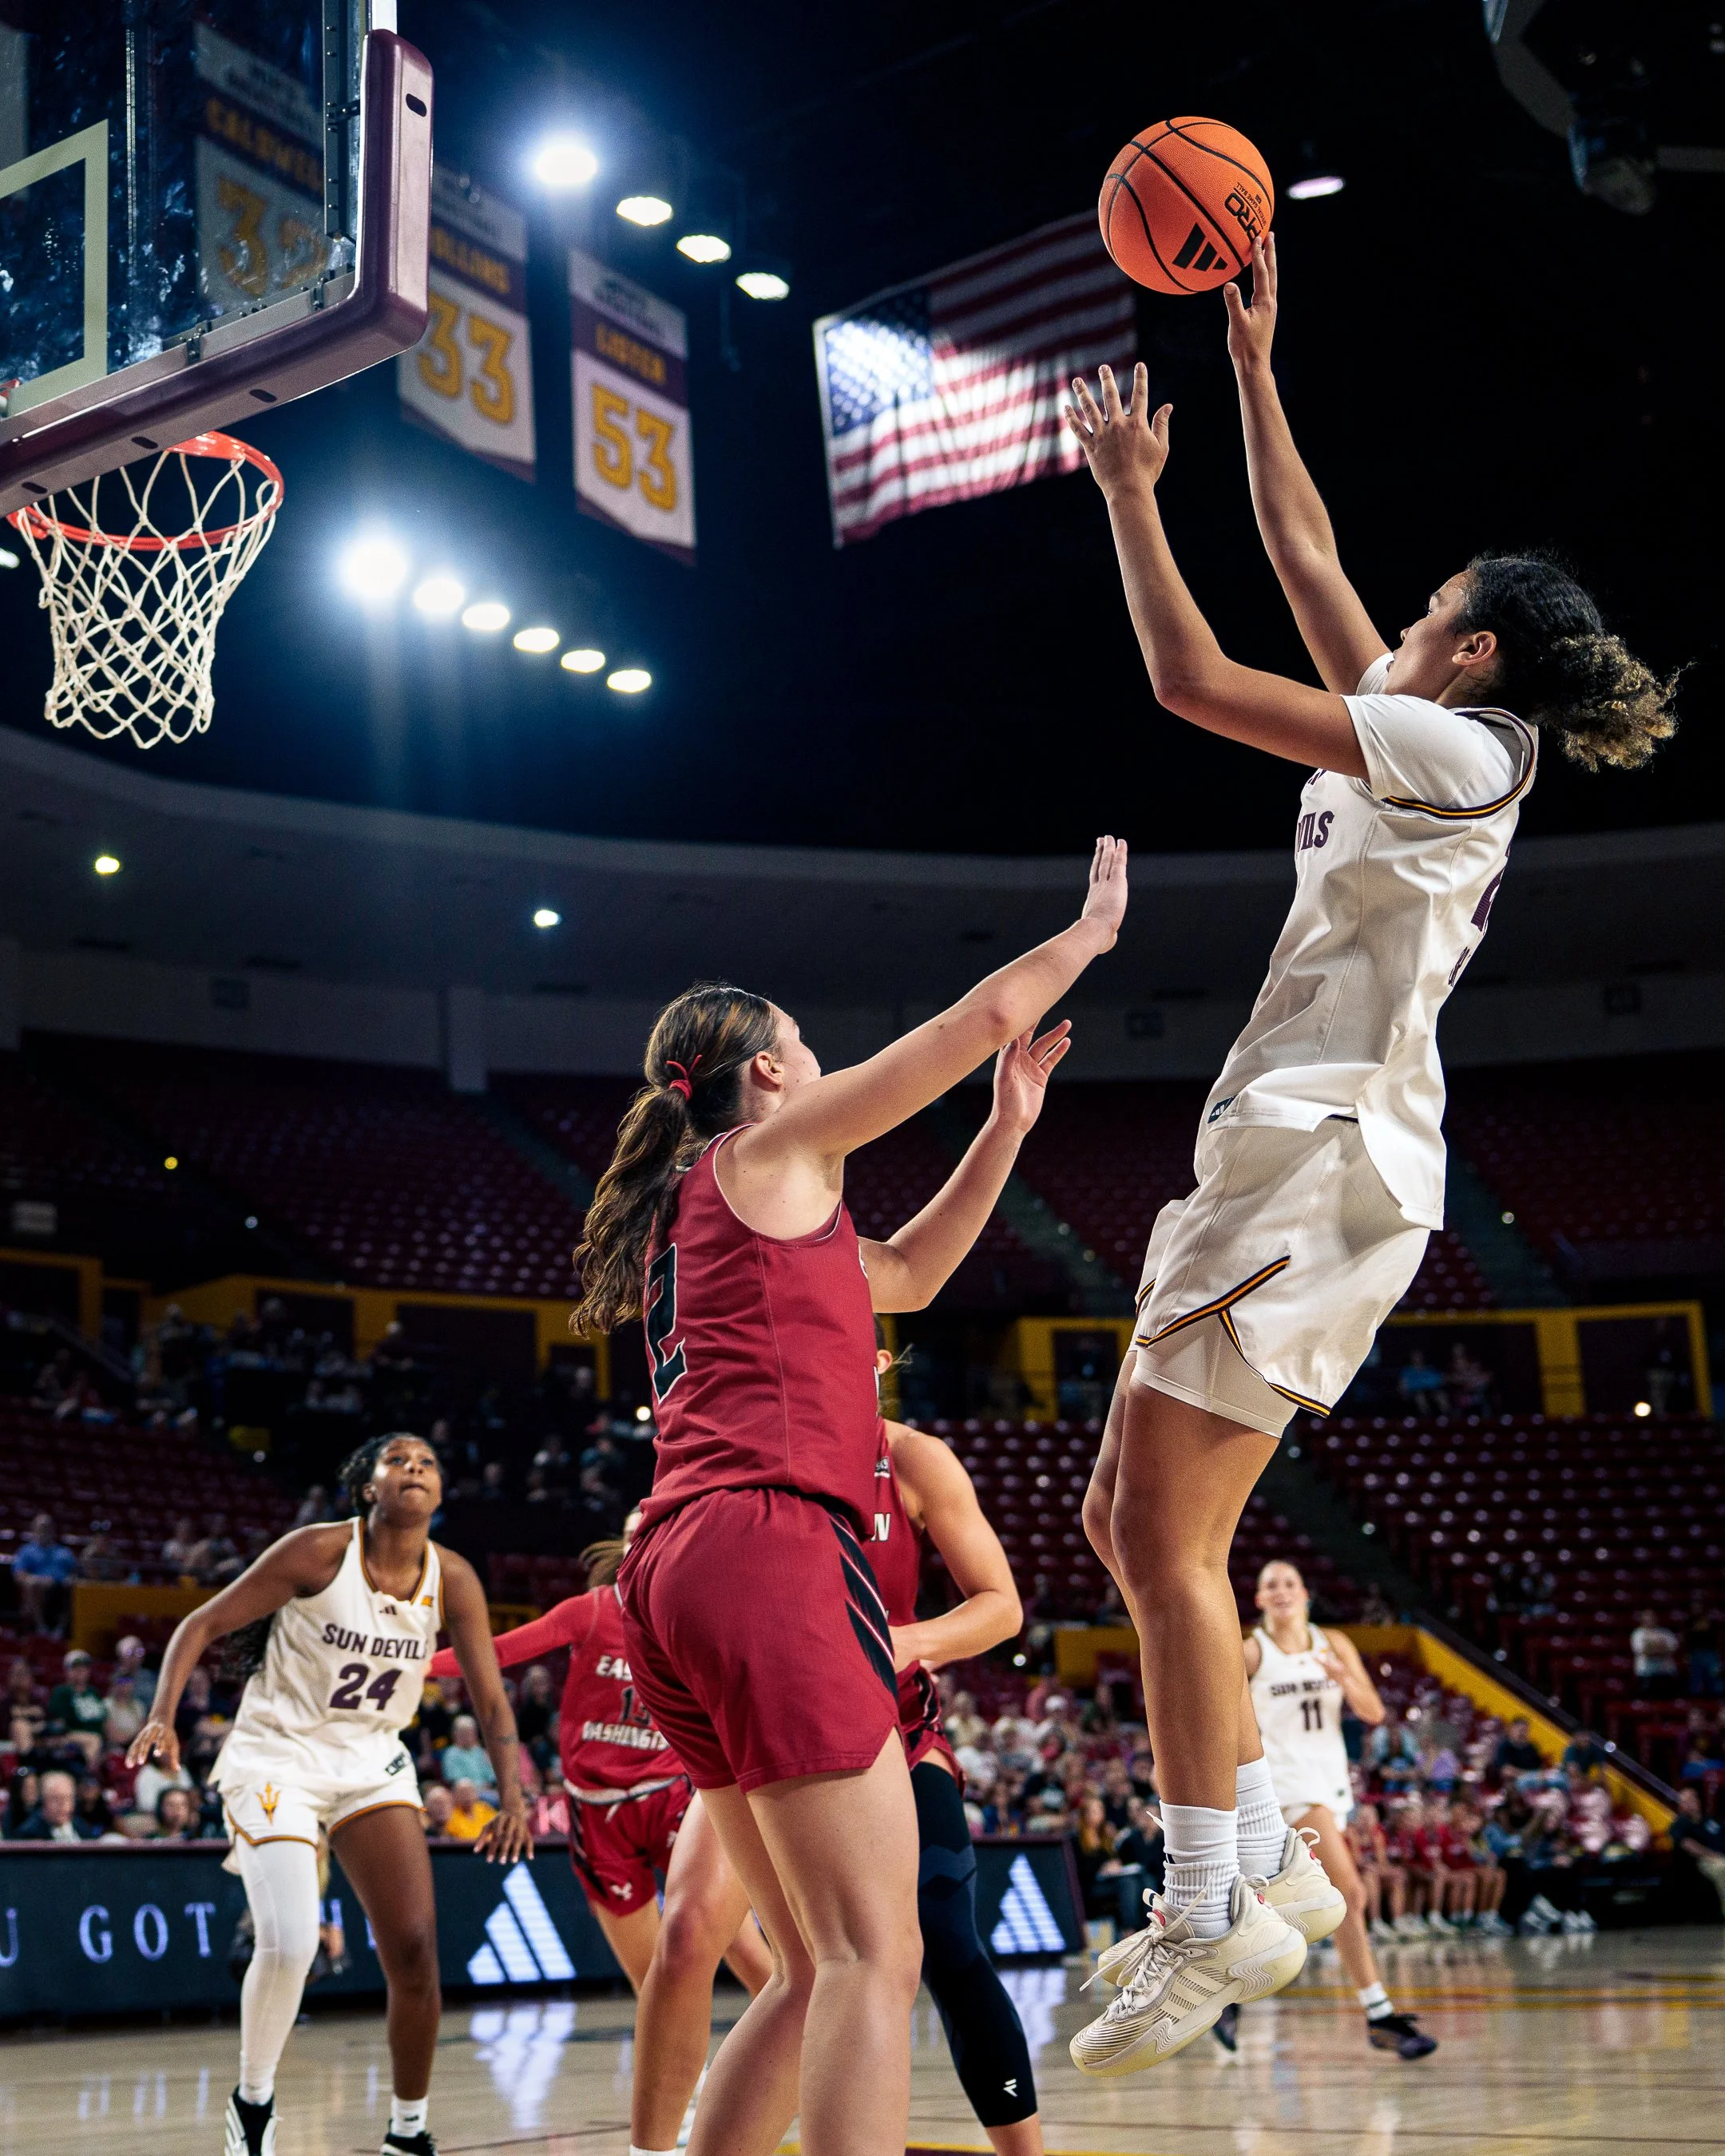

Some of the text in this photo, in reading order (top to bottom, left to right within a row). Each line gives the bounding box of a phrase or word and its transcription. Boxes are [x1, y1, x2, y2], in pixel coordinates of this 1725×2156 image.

[1237, 182, 1249, 196] BALL
[1224, 193, 1261, 244] PRO
[418, 291, 514, 423] 33
[592, 382, 676, 512] 53
[322, 1623, 428, 1660] SUN DEVIL
[329, 1663, 402, 1711] 24
[1299, 1698, 1323, 1732] 11
[78, 1902, 216, 1964] GOT
